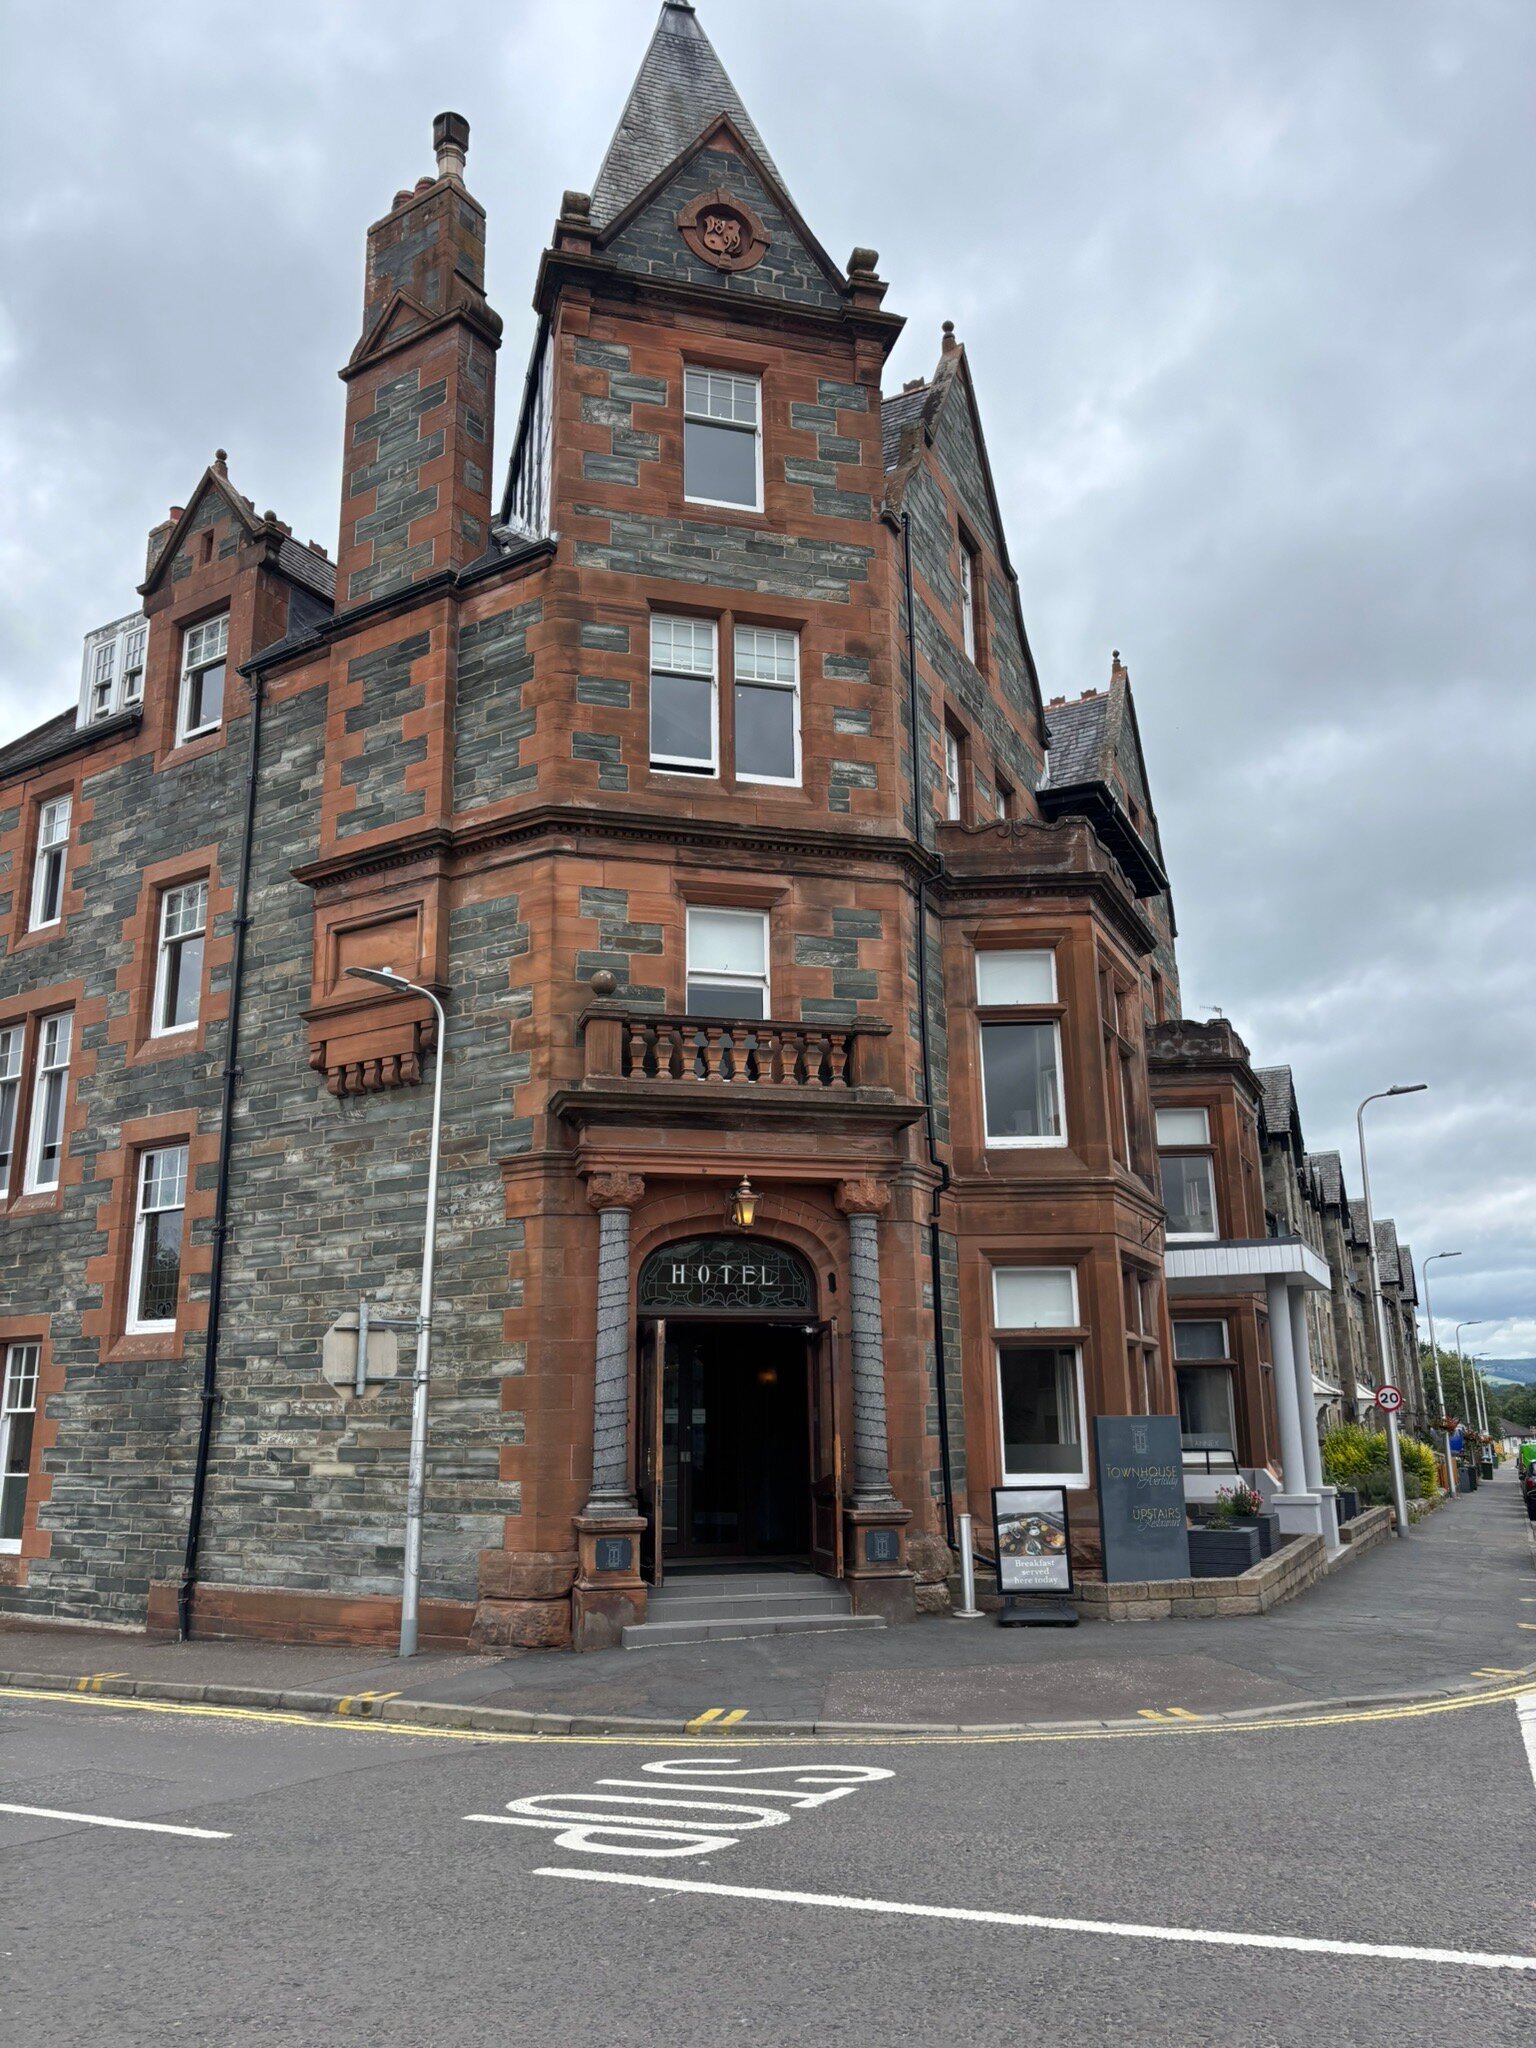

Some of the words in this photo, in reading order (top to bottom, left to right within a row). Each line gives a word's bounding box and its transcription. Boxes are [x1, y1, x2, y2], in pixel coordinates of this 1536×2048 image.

[671, 1263, 774, 1285] HOTEL
[1380, 1392, 1398, 1403] 20
[1106, 1466, 1177, 1478] TOWNHOUSE
[1132, 1507, 1181, 1519] UPSTAIRS
[1015, 1559, 1055, 1567] Breakfast
[1035, 1576, 1058, 1585] today
